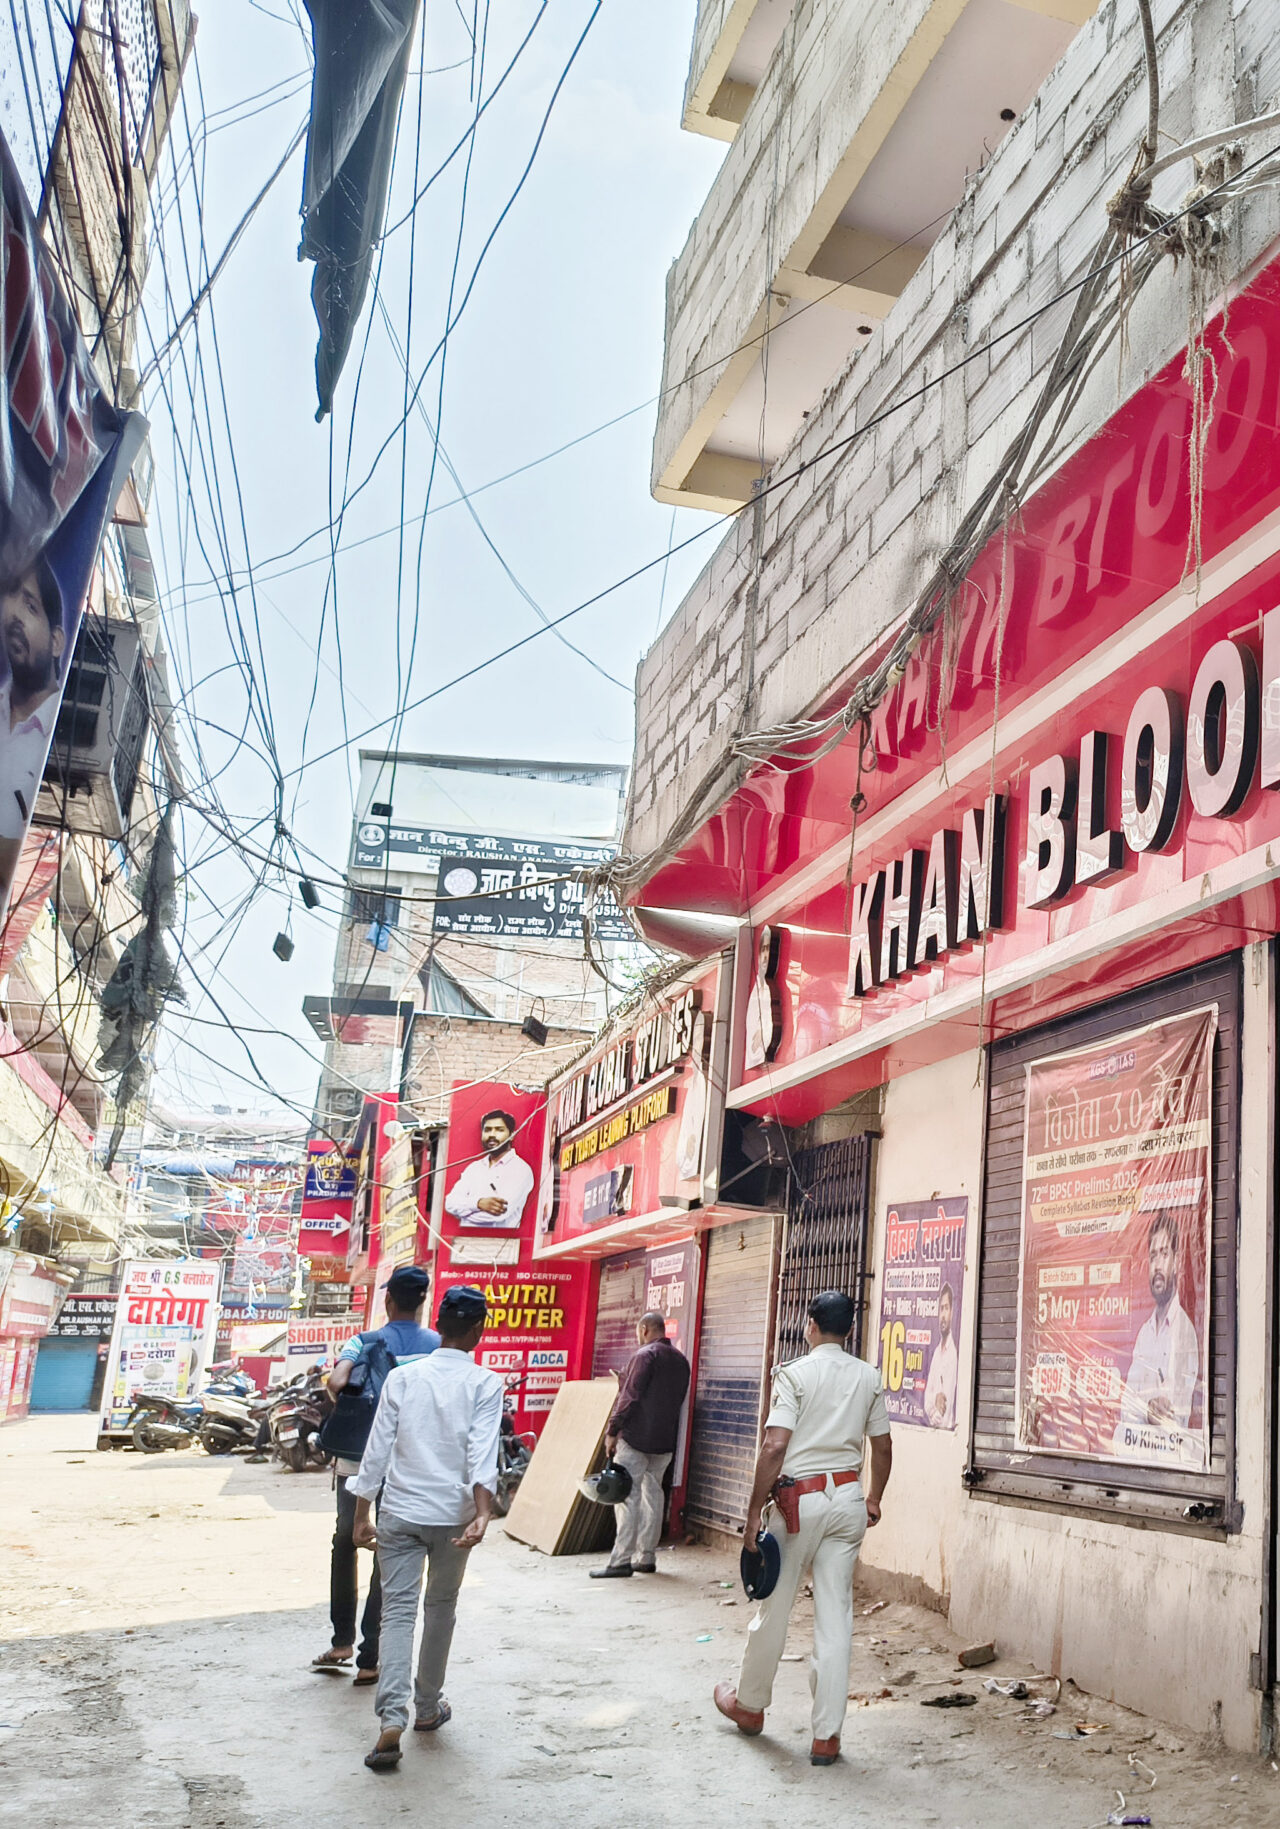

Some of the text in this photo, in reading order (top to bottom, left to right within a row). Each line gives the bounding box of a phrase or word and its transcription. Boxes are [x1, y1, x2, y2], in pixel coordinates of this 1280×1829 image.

[418, 846, 457, 857] Director
[466, 850, 517, 861] RAUSHAN
[847, 792, 1008, 999] KHAN
[1090, 1056, 1134, 1077] KGS IAS
[1044, 1087, 1102, 1148] विजेता
[1108, 1088, 1142, 1134] 3.0
[1050, 1180, 1073, 1199] BPSC
[1075, 1176, 1110, 1195] Prelims
[305, 1220, 342, 1229] OFFICE
[886, 1211, 919, 1263] बिहार
[516, 1272, 530, 1280] ISO
[532, 1273, 572, 1281] CERTIFIED
[1060, 1269, 1077, 1282] Starts
[1097, 1268, 1112, 1280] Time
[469, 1284, 556, 1305] AVITRI
[128, 1288, 210, 1329] दारोगा
[484, 1308, 564, 1329] MPUTER
[1051, 1295, 1080, 1326] May
[288, 1325, 362, 1344] SHORTHAN
[531, 1353, 564, 1365] ADCA
[881, 1321, 905, 1392] 16
[905, 1349, 923, 1373] April
[530, 1376, 563, 1385] TYPING
